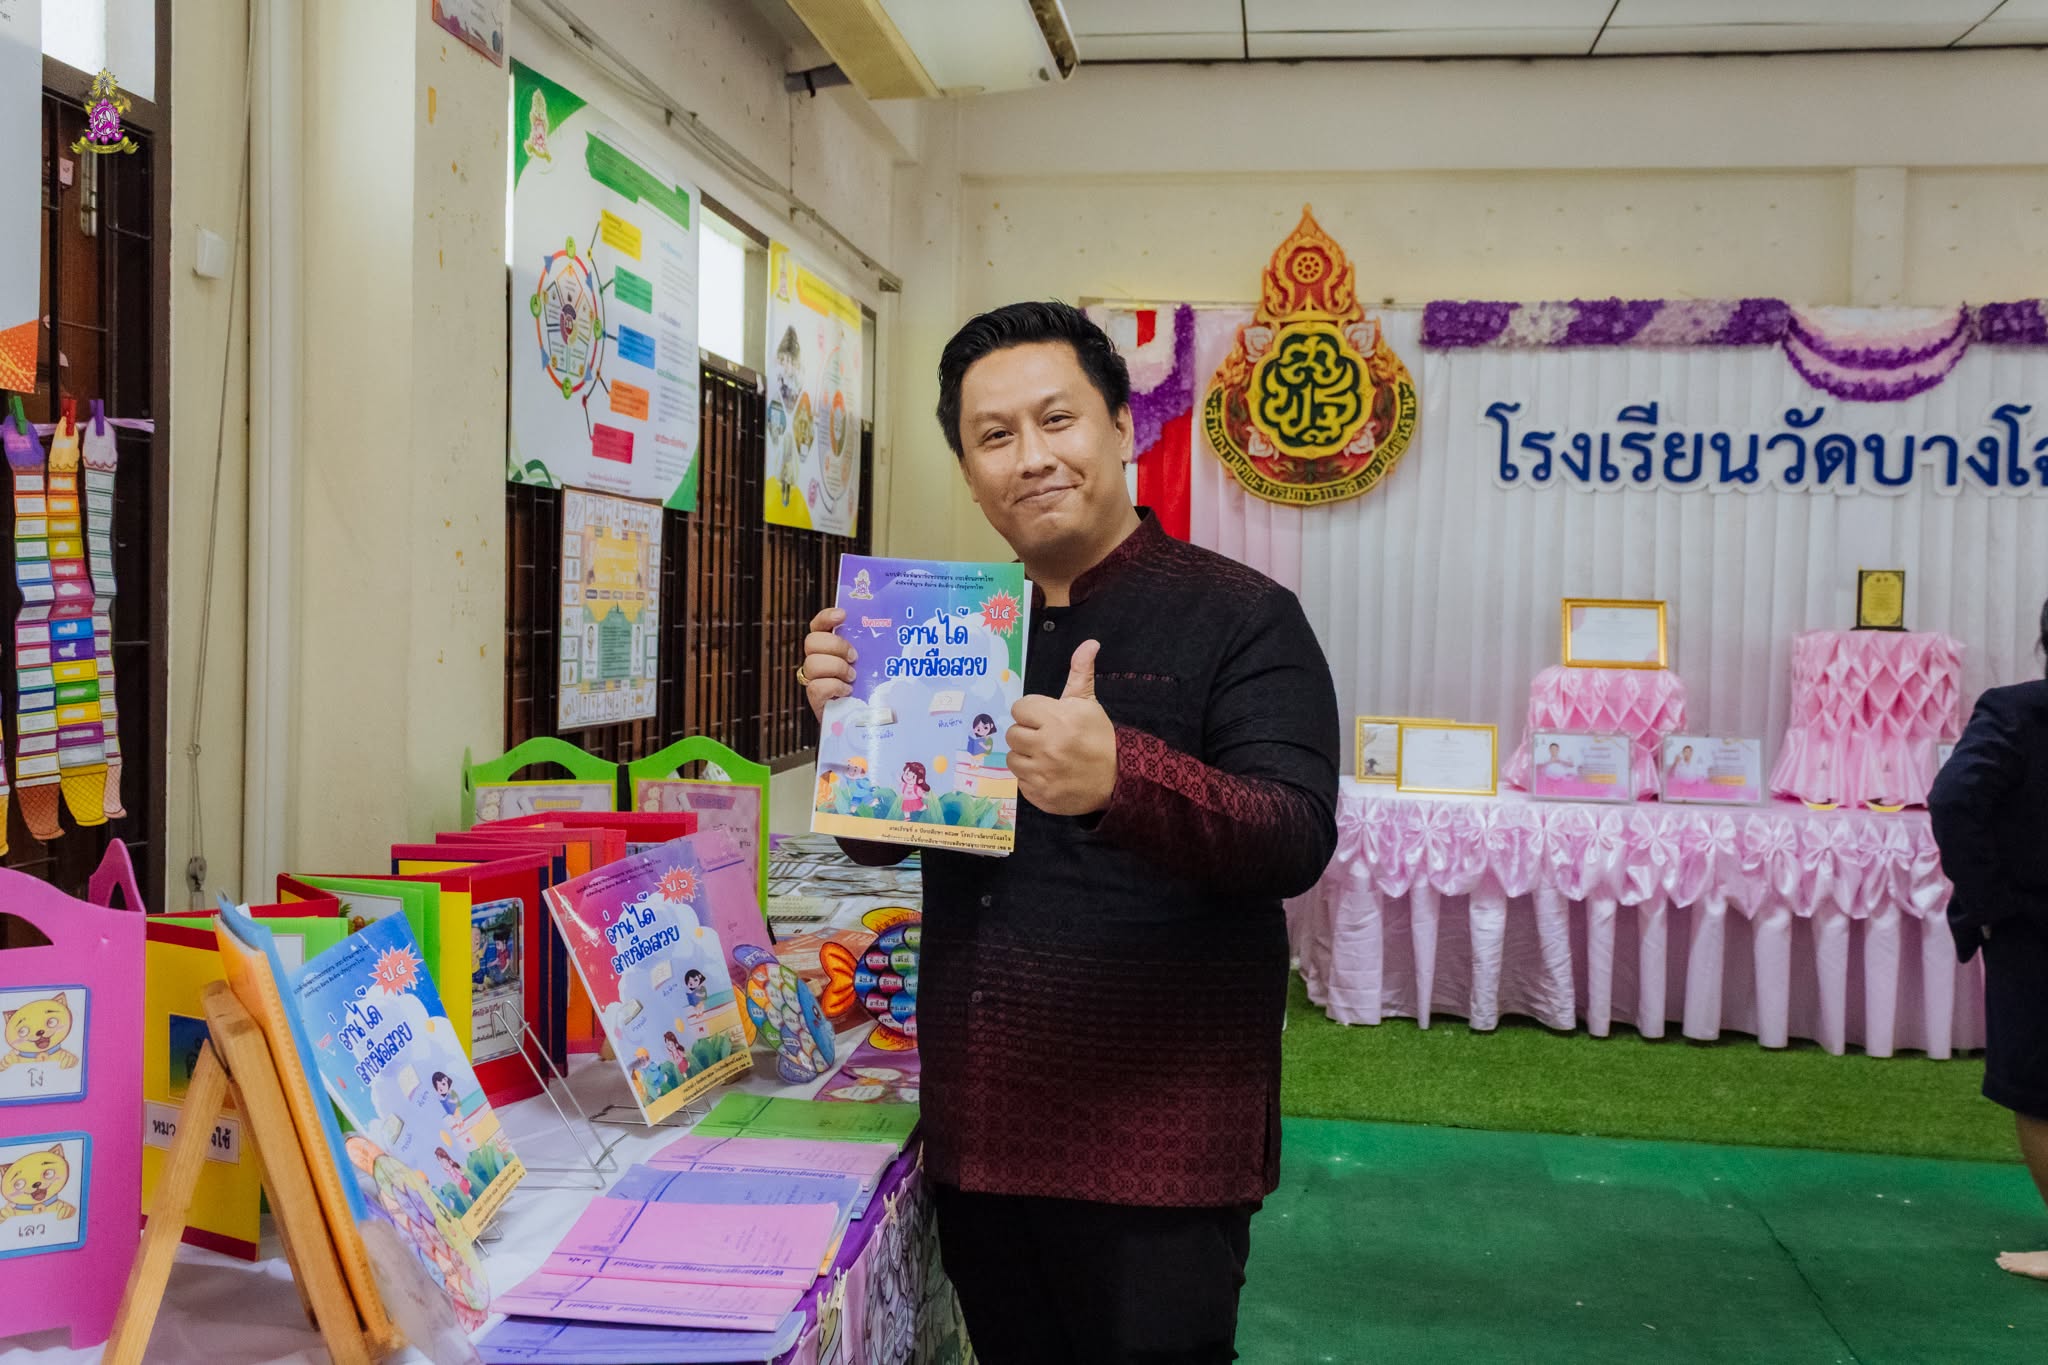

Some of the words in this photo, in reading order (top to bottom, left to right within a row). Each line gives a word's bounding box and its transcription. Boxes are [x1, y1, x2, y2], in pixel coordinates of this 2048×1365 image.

[990, 605, 1011, 619] ป.๕
[886, 648, 988, 677] ลายมือสวย
[666, 879, 688, 893] ป.๖
[611, 925, 680, 975] ลายมือสวย
[355, 1021, 413, 1085] ลายมือสวย
[18, 1223, 46, 1238] เลว
[613, 1260, 657, 1270] School
